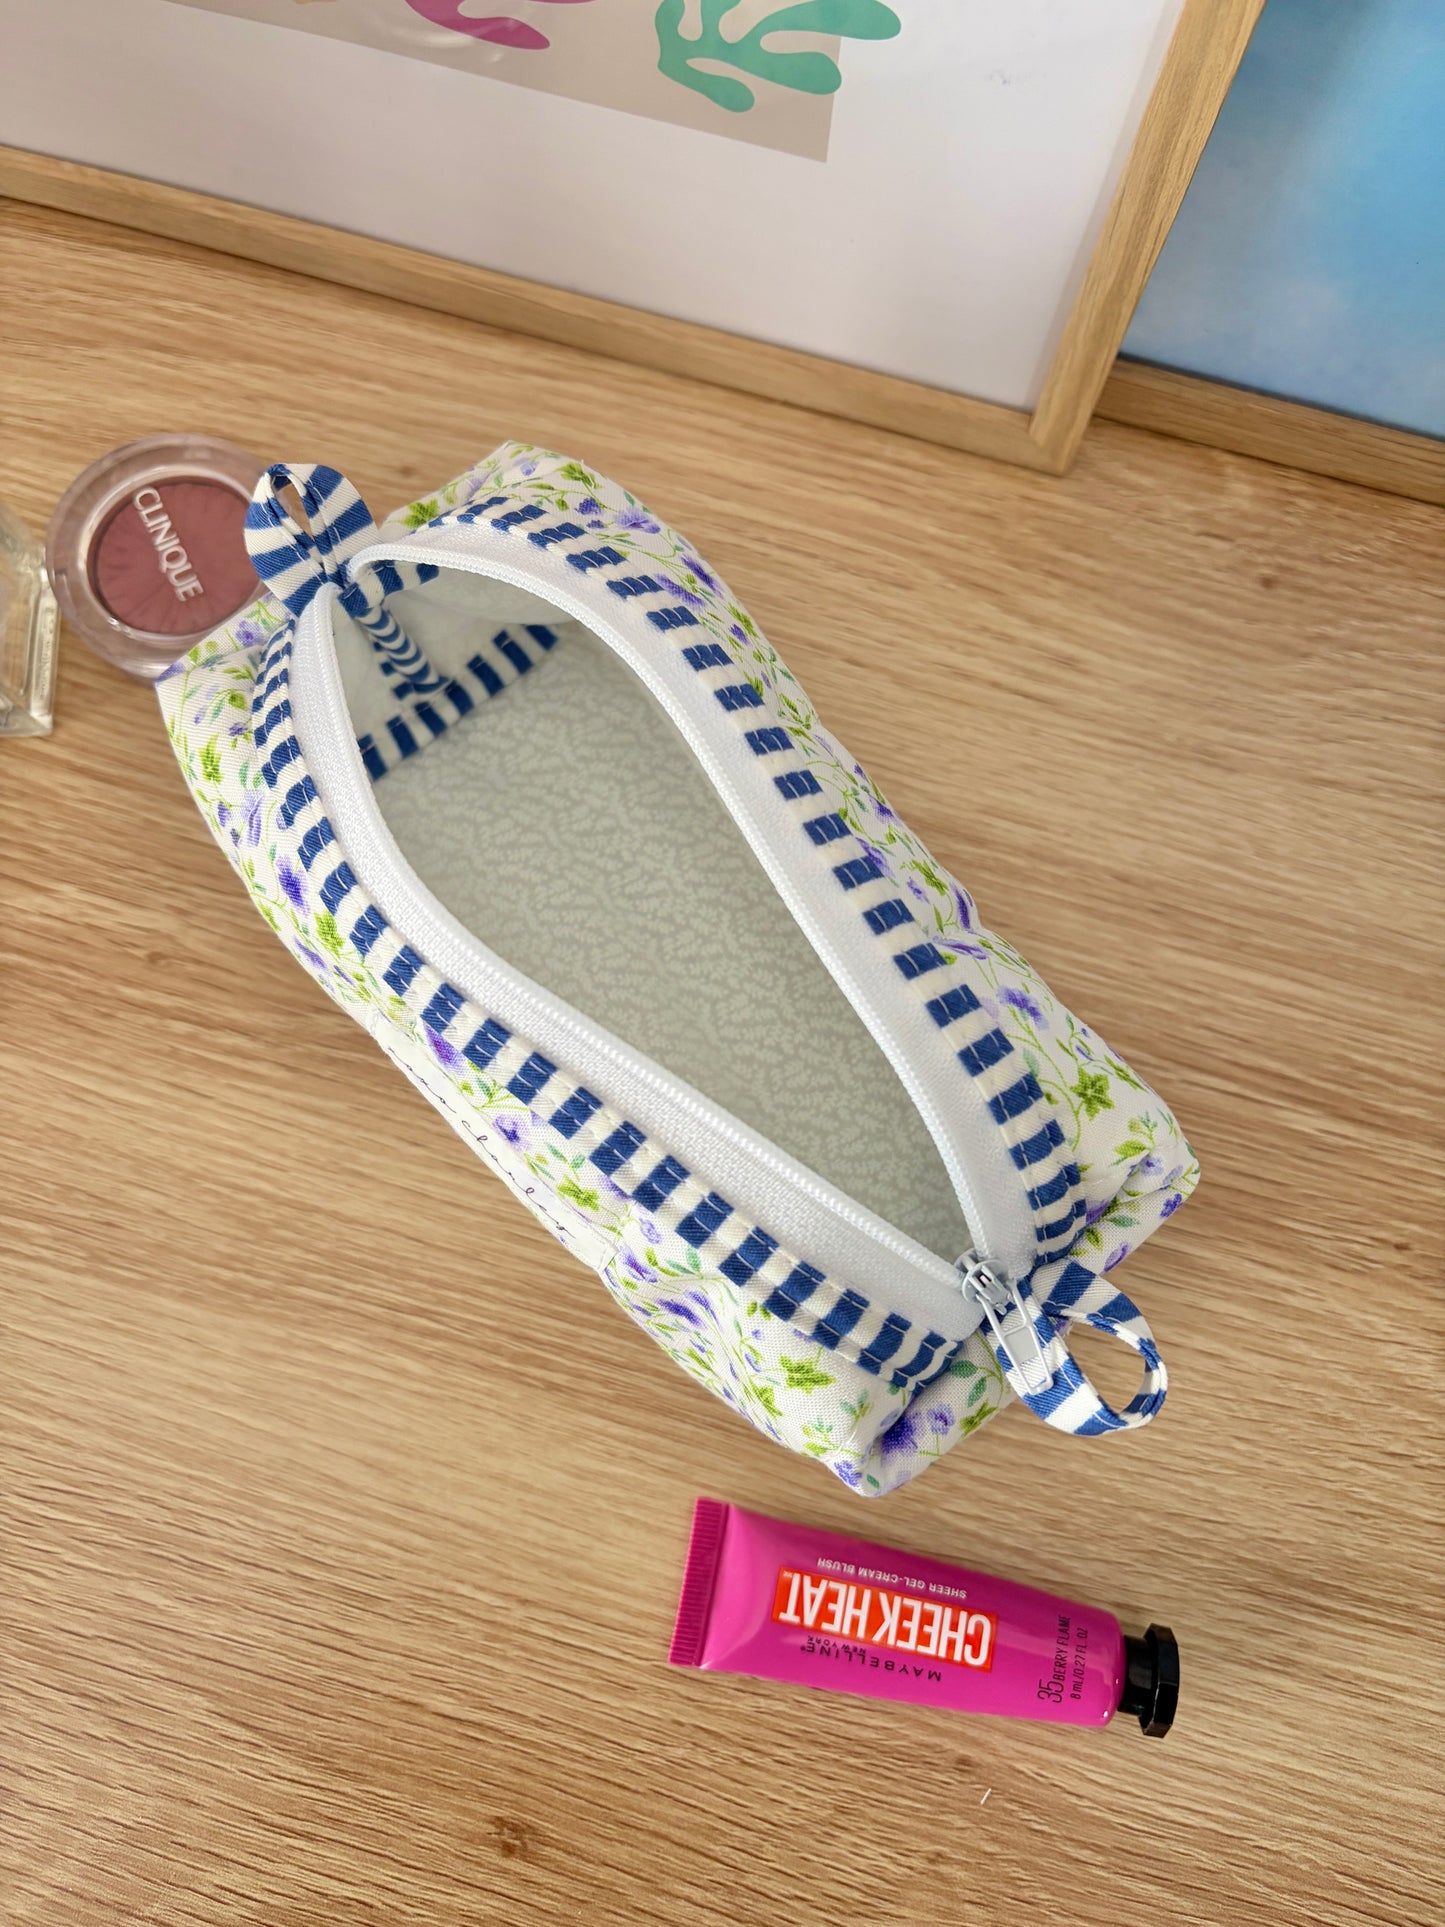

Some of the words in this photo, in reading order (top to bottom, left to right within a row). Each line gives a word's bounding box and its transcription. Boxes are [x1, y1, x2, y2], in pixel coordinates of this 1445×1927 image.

[133, 486, 204, 601] CLINIQUE
[817, 1557, 857, 1574] BLUSH
[857, 1566, 926, 1590] GEL-CREAM
[928, 1583, 967, 1599] SHEER
[779, 1573, 872, 1639] HEAT
[872, 1592, 991, 1666] CHEEK
[1056, 1614, 1071, 1646] FLAME
[1076, 1627, 1089, 1639] OZ
[807, 1635, 837, 1650] YORK
[840, 1643, 866, 1655] NEW
[1075, 1644, 1088, 1654] FL
[805, 1640, 942, 1681] MAYBELLINE
[1052, 1647, 1068, 1681] BERRY
[1037, 1679, 1064, 1703] 35
